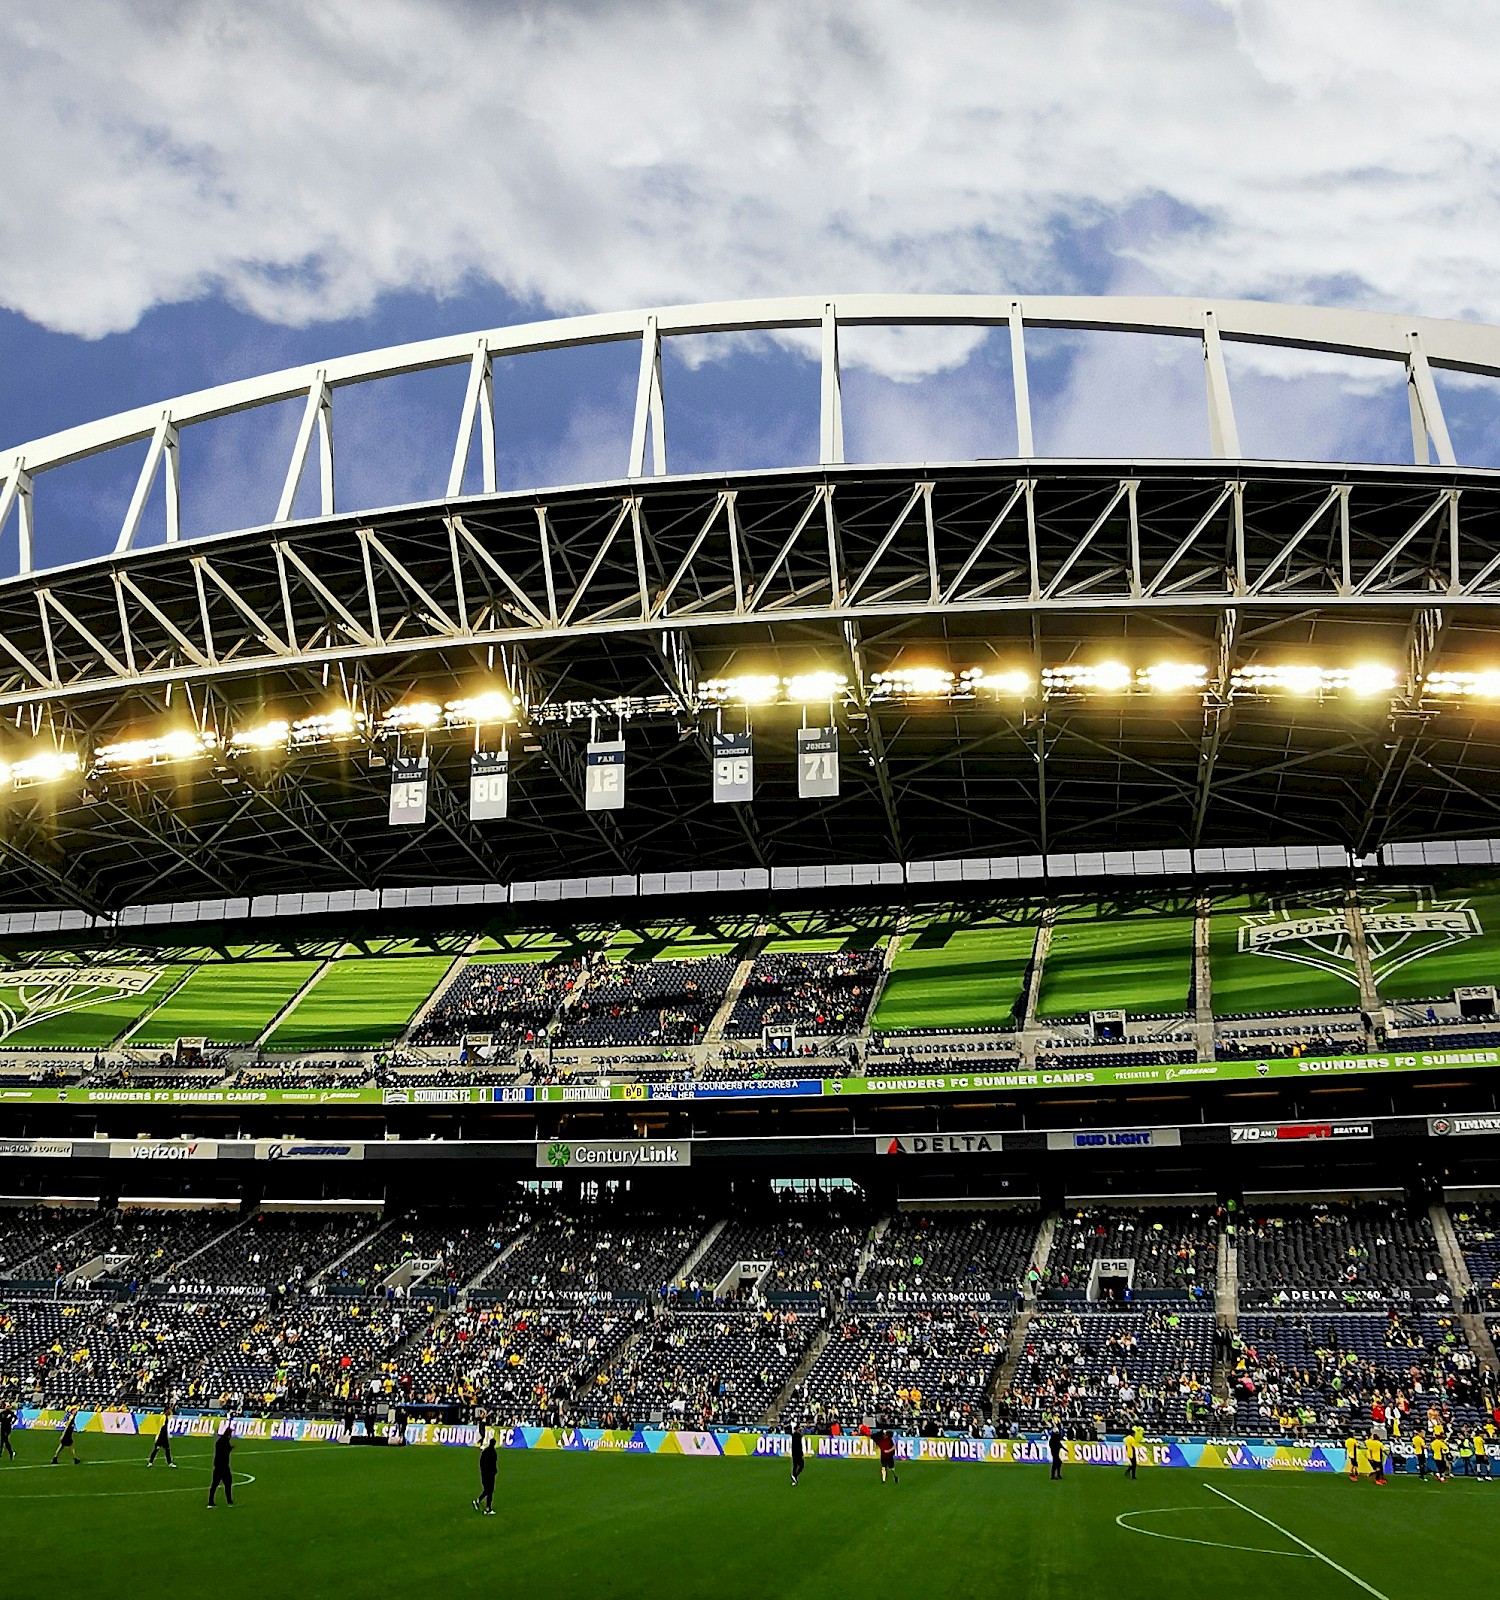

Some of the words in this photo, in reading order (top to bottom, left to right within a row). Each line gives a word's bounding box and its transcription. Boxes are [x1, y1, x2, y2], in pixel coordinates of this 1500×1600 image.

[805, 742, 831, 750] JONES
[597, 755, 615, 763] FAN
[717, 760, 749, 785] 96
[804, 755, 833, 780] 71
[592, 768, 618, 793] 12
[394, 783, 424, 808] 45
[474, 778, 504, 803] 80
[1427, 919, 1463, 930] FC
[117, 977, 144, 987] FC
[1096, 1011, 1120, 1019] 312
[1298, 1058, 1390, 1072] SOUNDERS
[1395, 1056, 1416, 1067] FC
[1421, 1052, 1499, 1066] SUMMER
[652, 1083, 677, 1092] WHEN
[678, 1083, 696, 1091] OUR
[698, 1082, 743, 1091] SOUNDERS
[744, 1081, 756, 1090] FC
[757, 1081, 791, 1089] SCORES
[792, 1080, 799, 1088] A
[866, 1079, 945, 1091] SOUNDERS
[950, 1078, 969, 1088] FC
[973, 1075, 1038, 1087] SUMMER
[1042, 1072, 1095, 1084] CAMPS
[88, 1092, 151, 1100] SOUNDERS
[154, 1092, 169, 1100] FC
[172, 1093, 223, 1101] SUMMER
[226, 1093, 267, 1101] CAMPS
[414, 1090, 458, 1102] SOUNDERS
[459, 1090, 471, 1101] FC
[479, 1088, 487, 1101] 0
[501, 1088, 526, 1101] 0:00
[541, 1088, 549, 1101] 0
[562, 1087, 611, 1099] DORTMUND
[625, 1084, 643, 1097] BVB
[1231, 1128, 1260, 1141] 710
[1333, 1127, 1369, 1135] SEATTLE
[913, 1136, 993, 1152] DELTA
[1076, 1134, 1107, 1146] BUD
[1107, 1132, 1150, 1146] LIGHT
[129, 1144, 189, 1159] verizon
[575, 1146, 678, 1164] CenturyLink
[179, 1284, 213, 1294] DELTA
[1291, 1290, 1338, 1300] DELTA
[888, 1292, 928, 1301] DELTA
[167, 1417, 215, 1434] OFFICIAL
[270, 1421, 300, 1438] CARE
[499, 1428, 515, 1446] FC
[582, 1437, 614, 1449] Virginia
[615, 1438, 644, 1449] Mason
[818, 1438, 877, 1456] MEDICAL
[920, 1440, 986, 1458] PROVIDER
[990, 1441, 1008, 1459] OF
[1153, 1445, 1171, 1464] FC
[1251, 1455, 1290, 1468] Virginia
[1292, 1455, 1327, 1468] Mason
